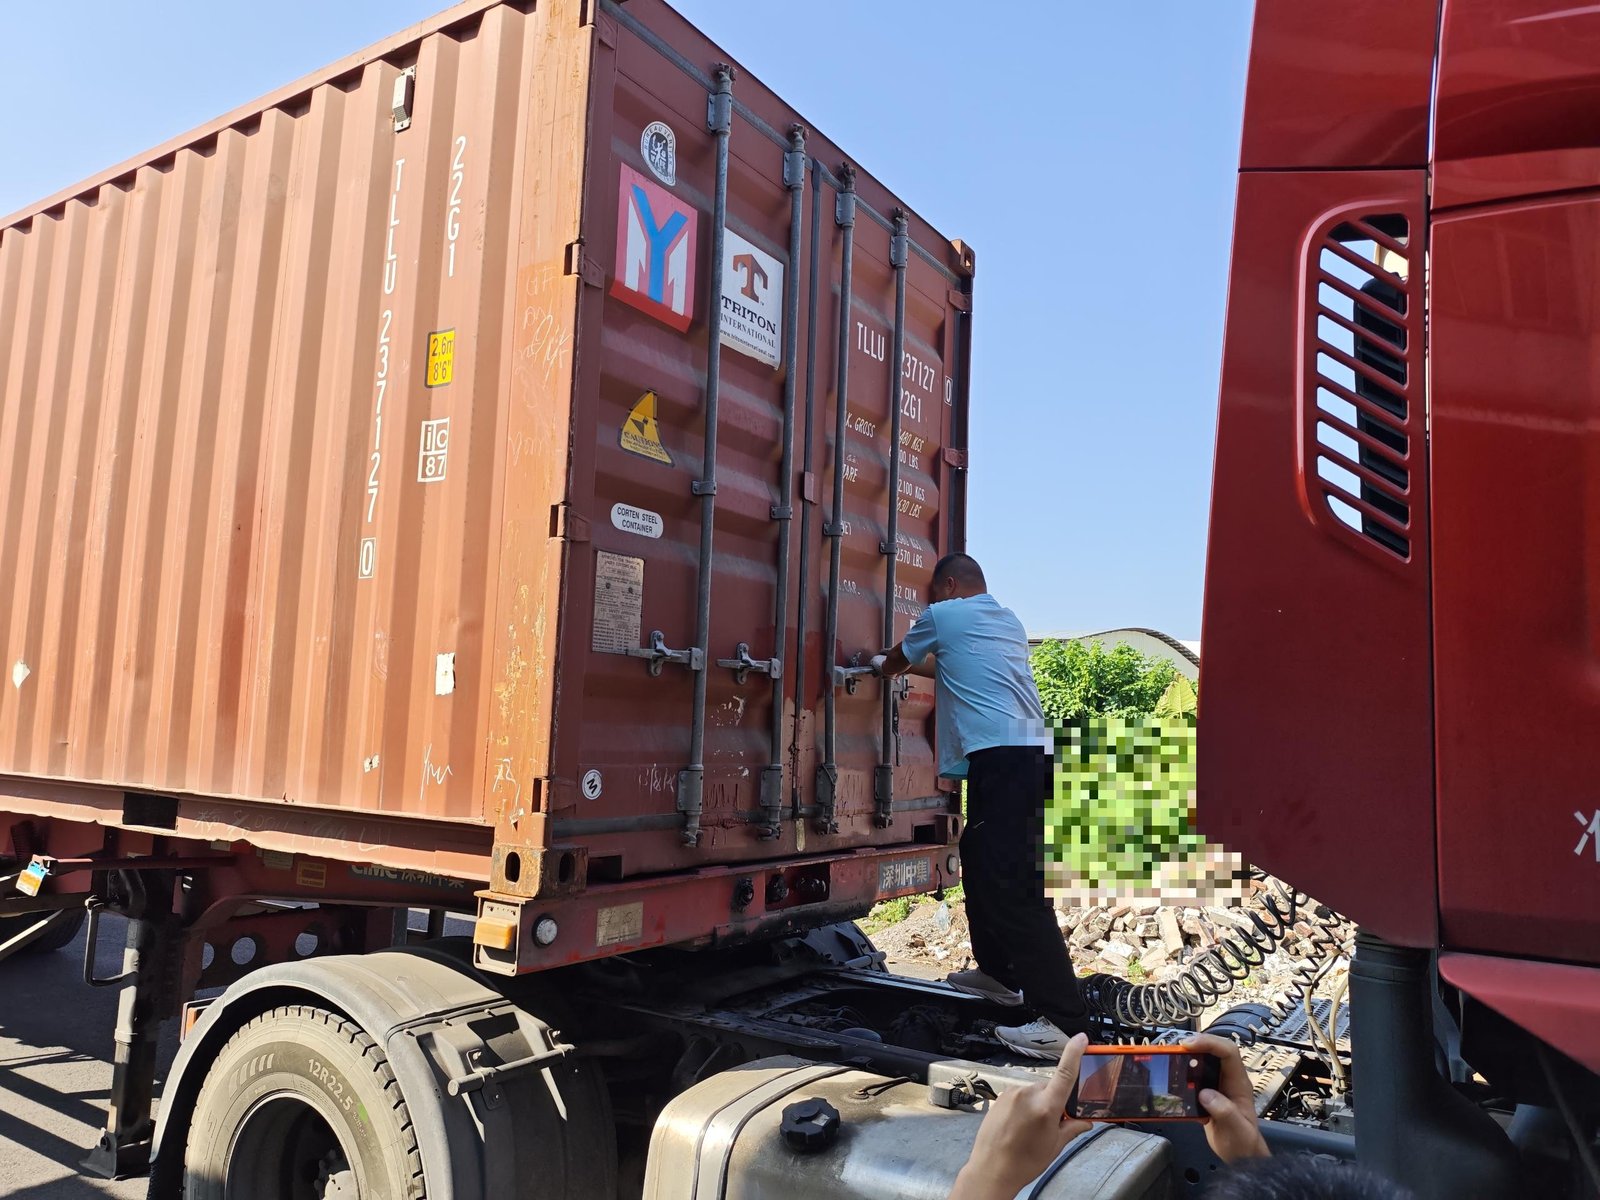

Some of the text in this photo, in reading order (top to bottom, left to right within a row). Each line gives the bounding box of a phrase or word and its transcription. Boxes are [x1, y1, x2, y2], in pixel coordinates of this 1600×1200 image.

[446, 135, 466, 277] 22G1
[383, 158, 405, 295] TLLU
[720, 313, 776, 348] INTERNATIONAL
[721, 295, 776, 335] TRITON
[857, 321, 885, 362] TLLU
[366, 309, 393, 524] 237127
[854, 417, 876, 438] GROSS
[425, 456, 445, 477] 87
[617, 506, 659, 525] CORTEN STEEL
[621, 519, 653, 534] CONTAINER
[881, 859, 929, 890] 深圳中集
[308, 1058, 354, 1111] 12R22.5
